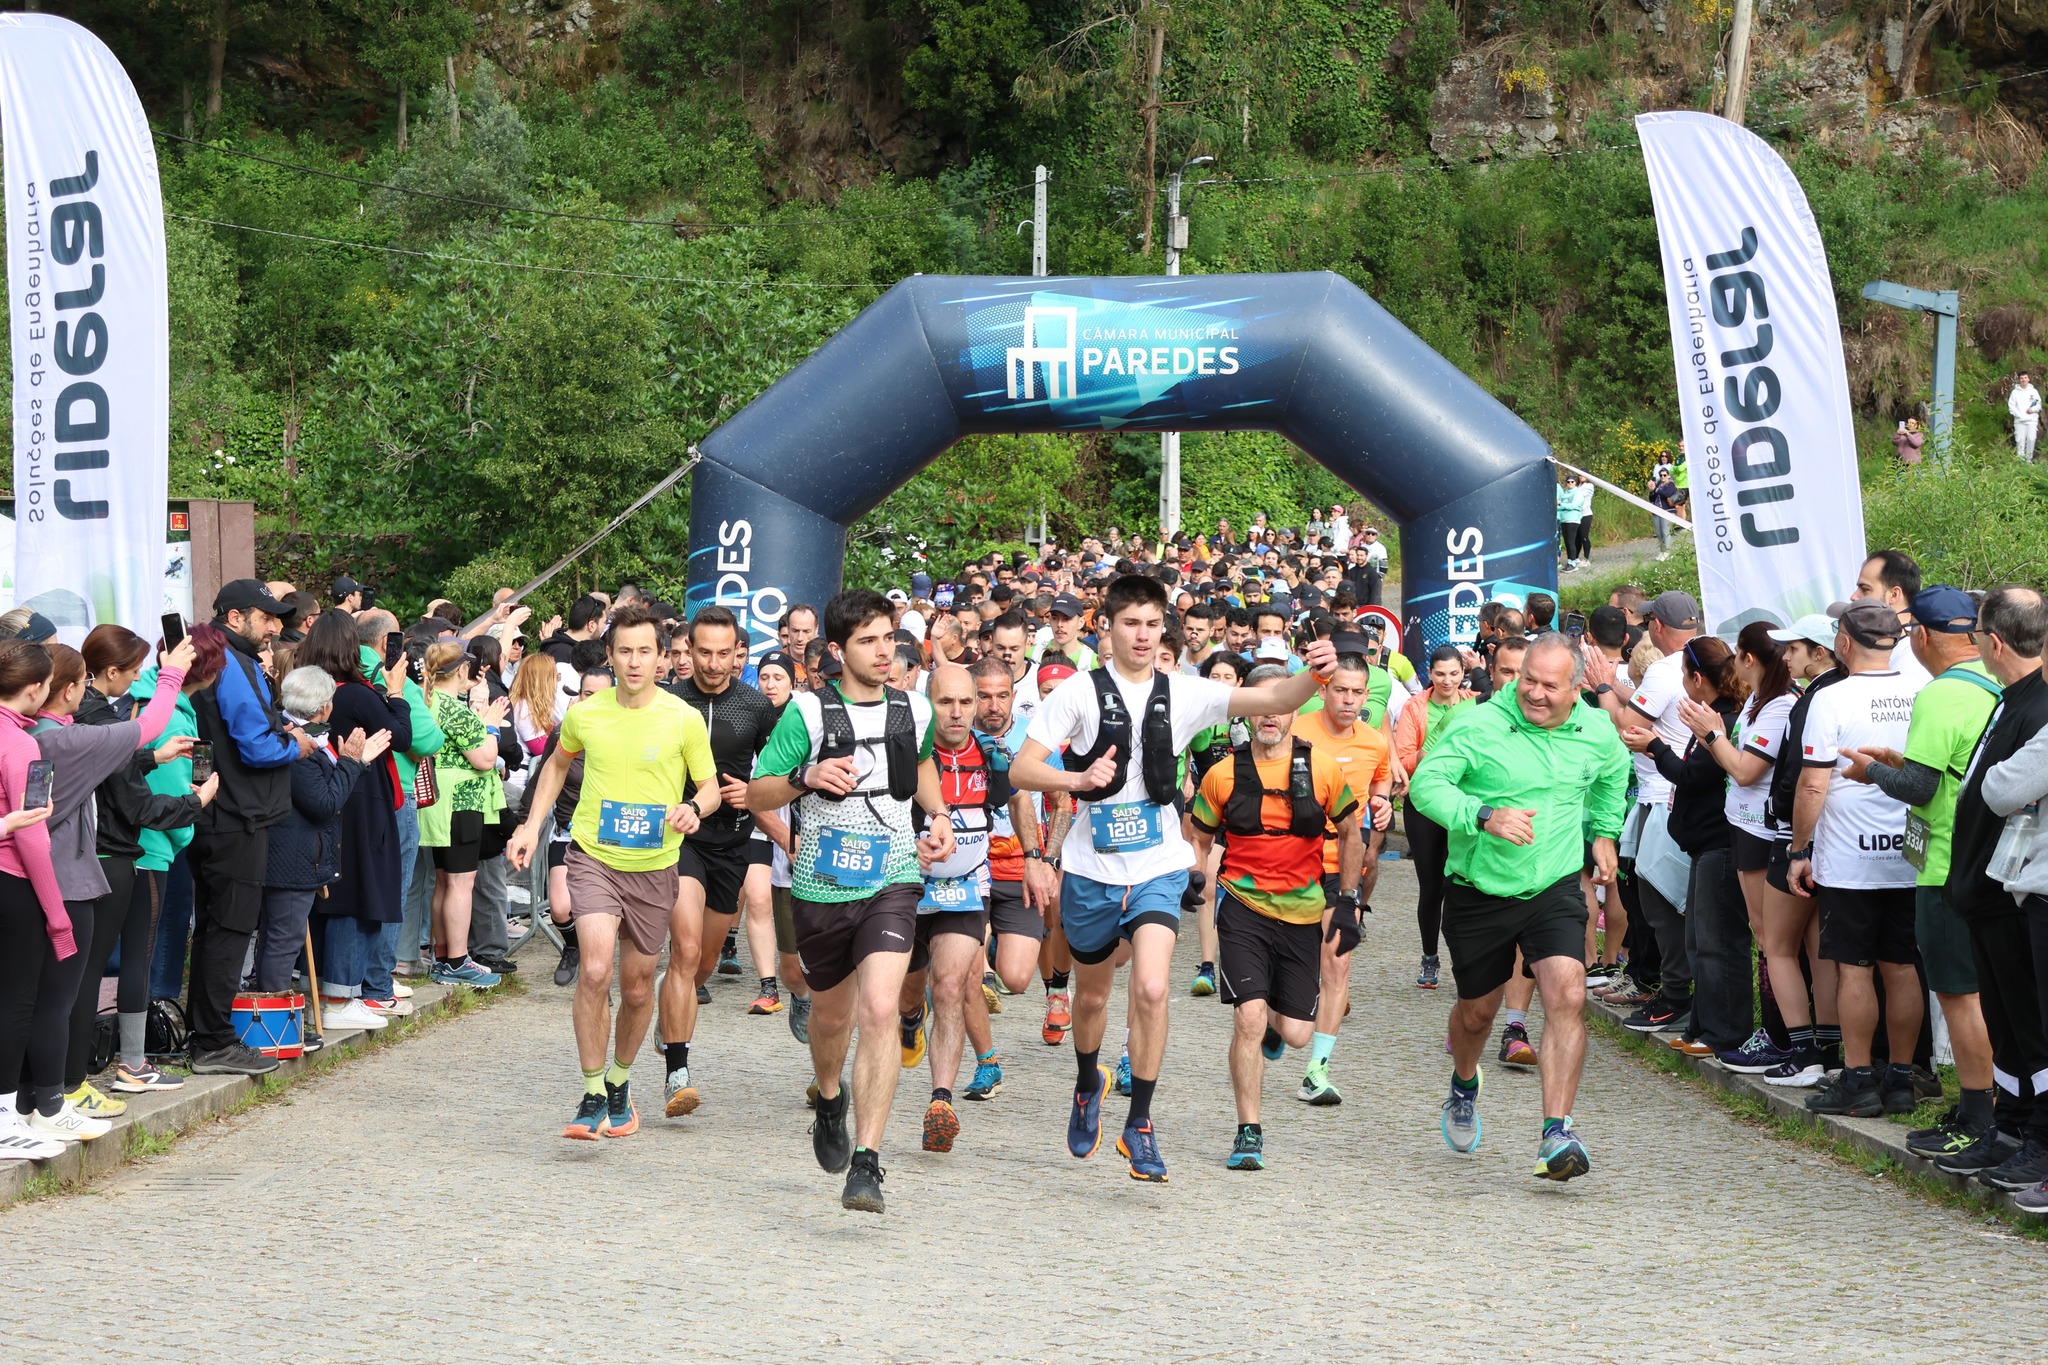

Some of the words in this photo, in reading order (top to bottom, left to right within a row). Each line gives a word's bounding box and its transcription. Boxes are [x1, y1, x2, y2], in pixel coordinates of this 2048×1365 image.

[1082, 325, 1149, 341] CÂMARA
[1154, 327, 1240, 341] MUNICIPAL
[1082, 346, 1240, 376] PAREDES
[715, 519, 753, 628] DES
[1446, 526, 1485, 650] EDES
[748, 586, 788, 665] VO
[620, 806, 648, 817] SALTO
[1111, 806, 1142, 818] SALTO
[613, 818, 651, 835] 1342
[1106, 818, 1148, 838] 1203
[840, 837, 872, 851] SALTO
[954, 833, 985, 846] OLIDO
[1905, 830, 1924, 855] 3334
[831, 849, 874, 871] 1363
[929, 887, 967, 902] 1280
